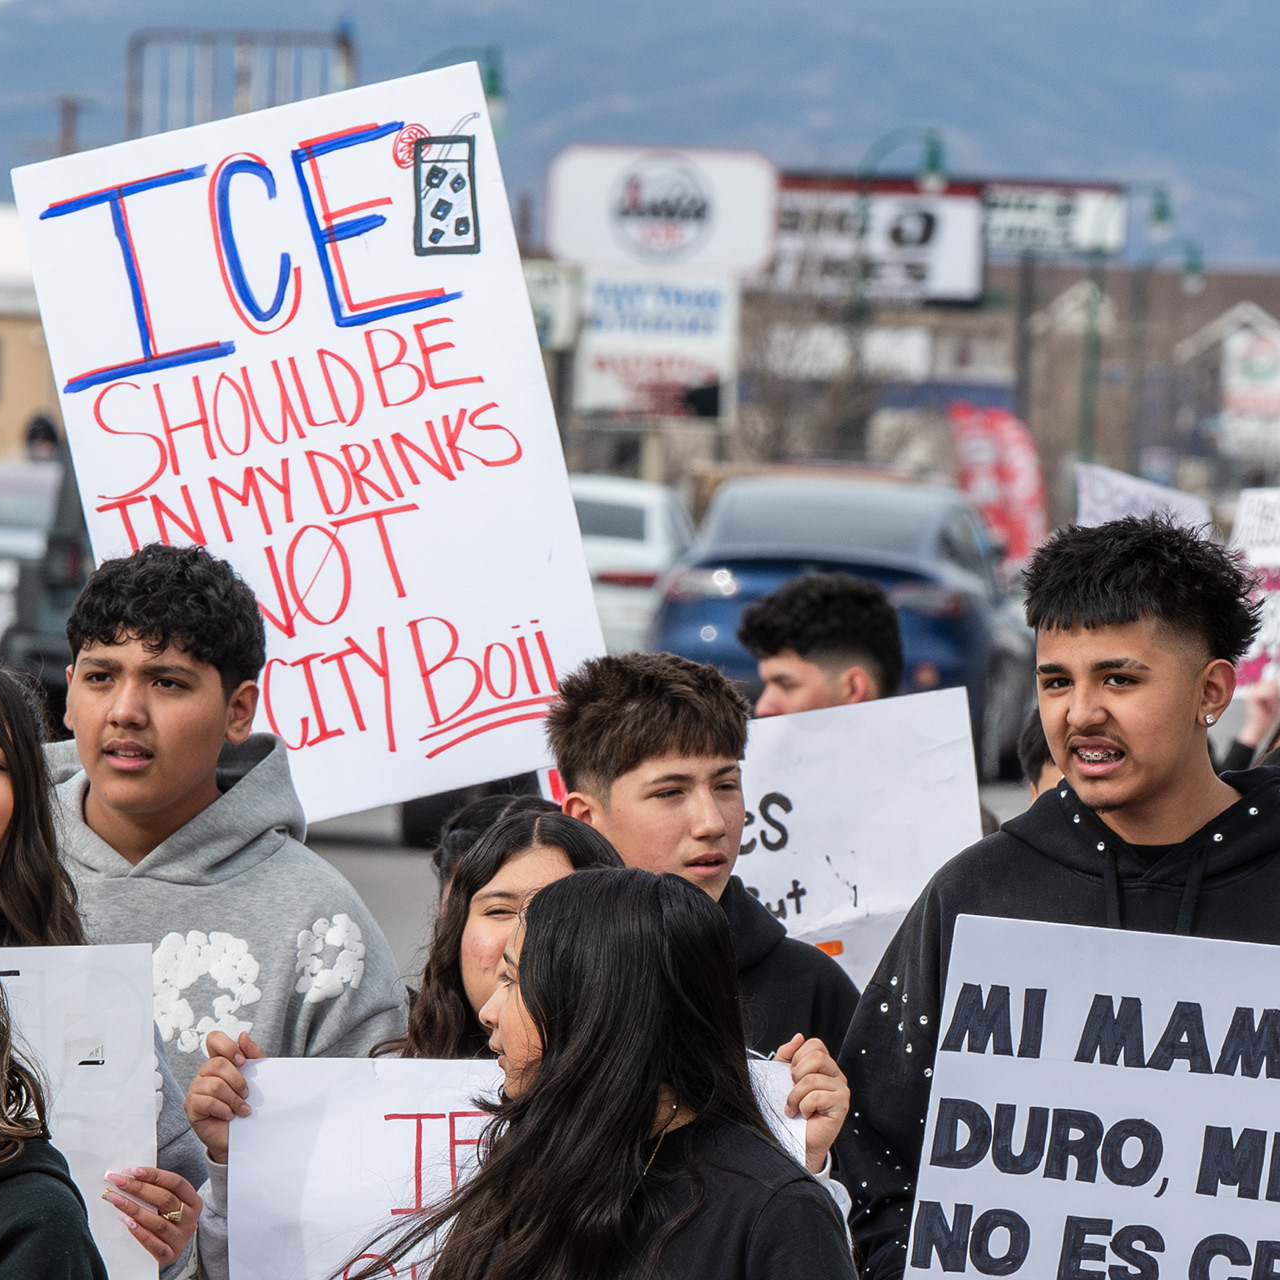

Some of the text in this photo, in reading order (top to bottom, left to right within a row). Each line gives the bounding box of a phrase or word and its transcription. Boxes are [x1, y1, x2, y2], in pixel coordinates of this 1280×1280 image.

[39, 120, 465, 394] ICE
[93, 347, 364, 500] SHOULD
[364, 316, 485, 408] BE
[96, 401, 524, 552] IN MY DRINKS
[263, 625, 398, 753] CITY
[939, 981, 1048, 1059] MI
[928, 1096, 1170, 1199] DURO,
[909, 1199, 1032, 1277] NO
